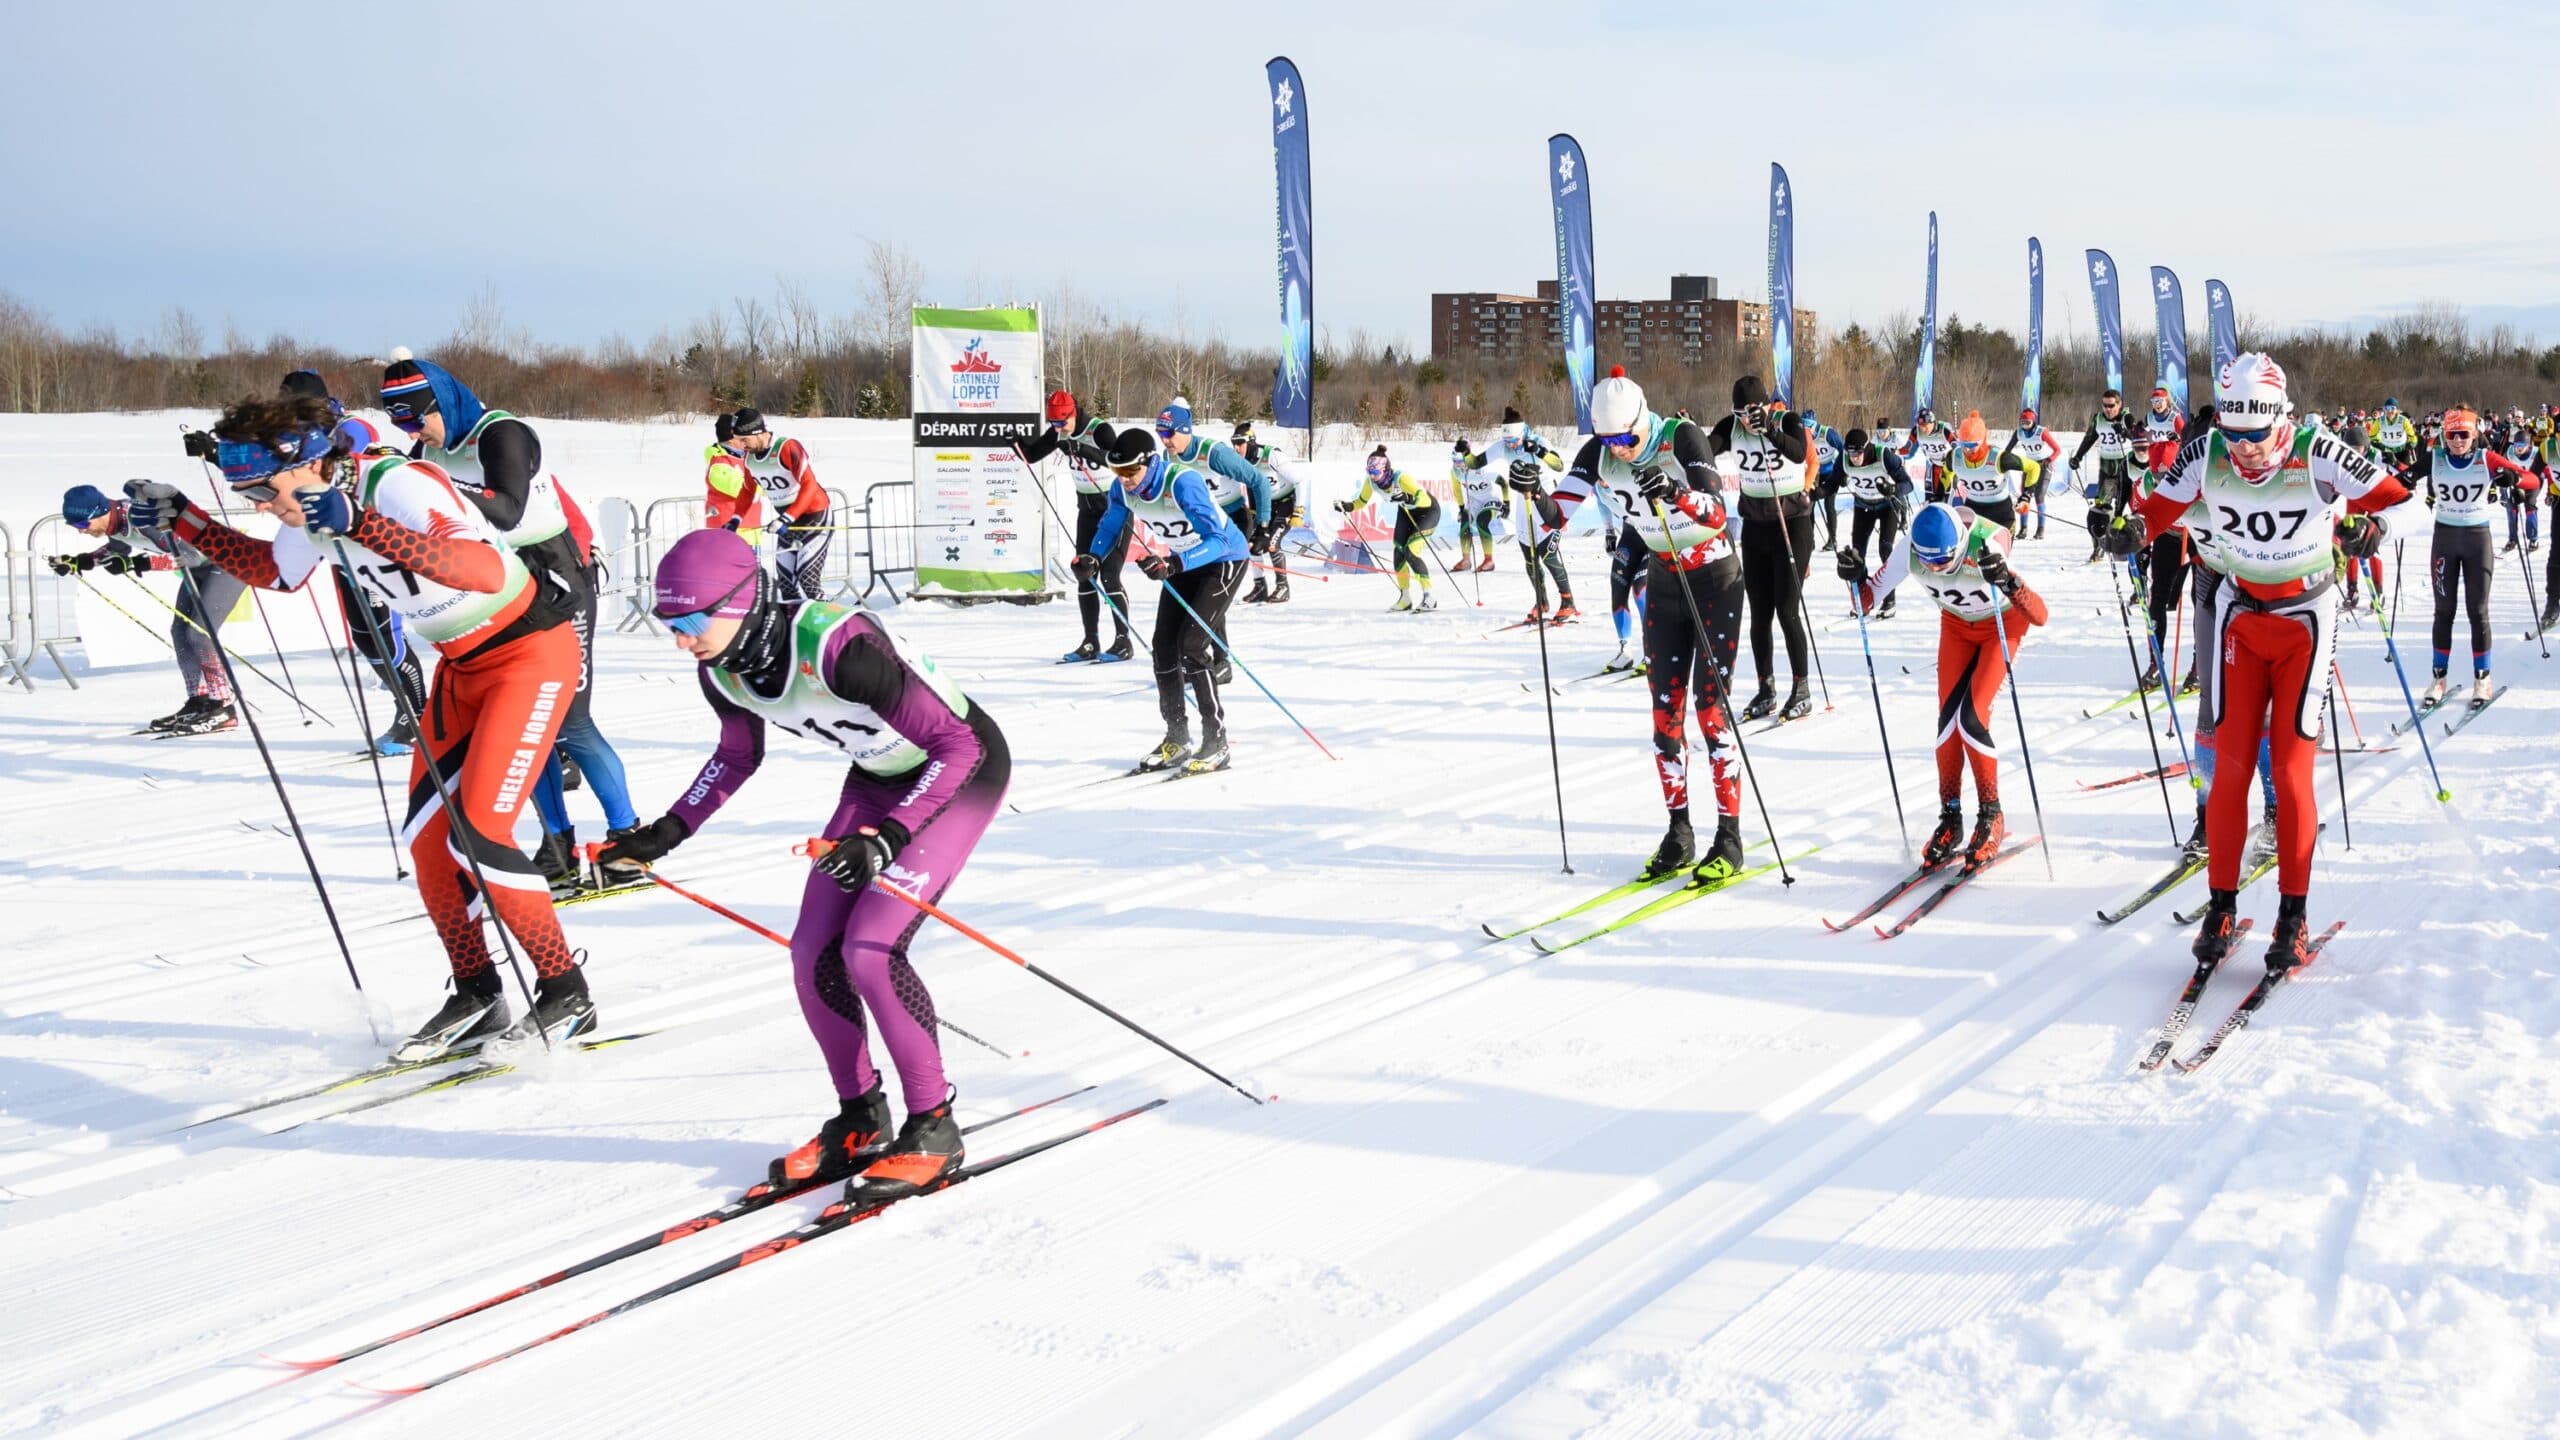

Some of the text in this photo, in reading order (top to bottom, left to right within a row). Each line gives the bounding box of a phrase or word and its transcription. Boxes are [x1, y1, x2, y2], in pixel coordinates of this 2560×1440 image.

[952, 373, 1000, 384] GATINEAU
[952, 385, 1000, 399] LOPPET
[921, 420, 1035, 437] DÉPART / START
[1737, 450, 1784, 472] 223
[2335, 444, 2378, 485] TEAM
[1613, 489, 1681, 518] 21
[2437, 483, 2484, 503] 307
[2218, 505, 2308, 543] 207
[2235, 542, 2319, 560] Ville de Gatineau
[493, 681, 563, 813] CHELSEA NORDIQ
